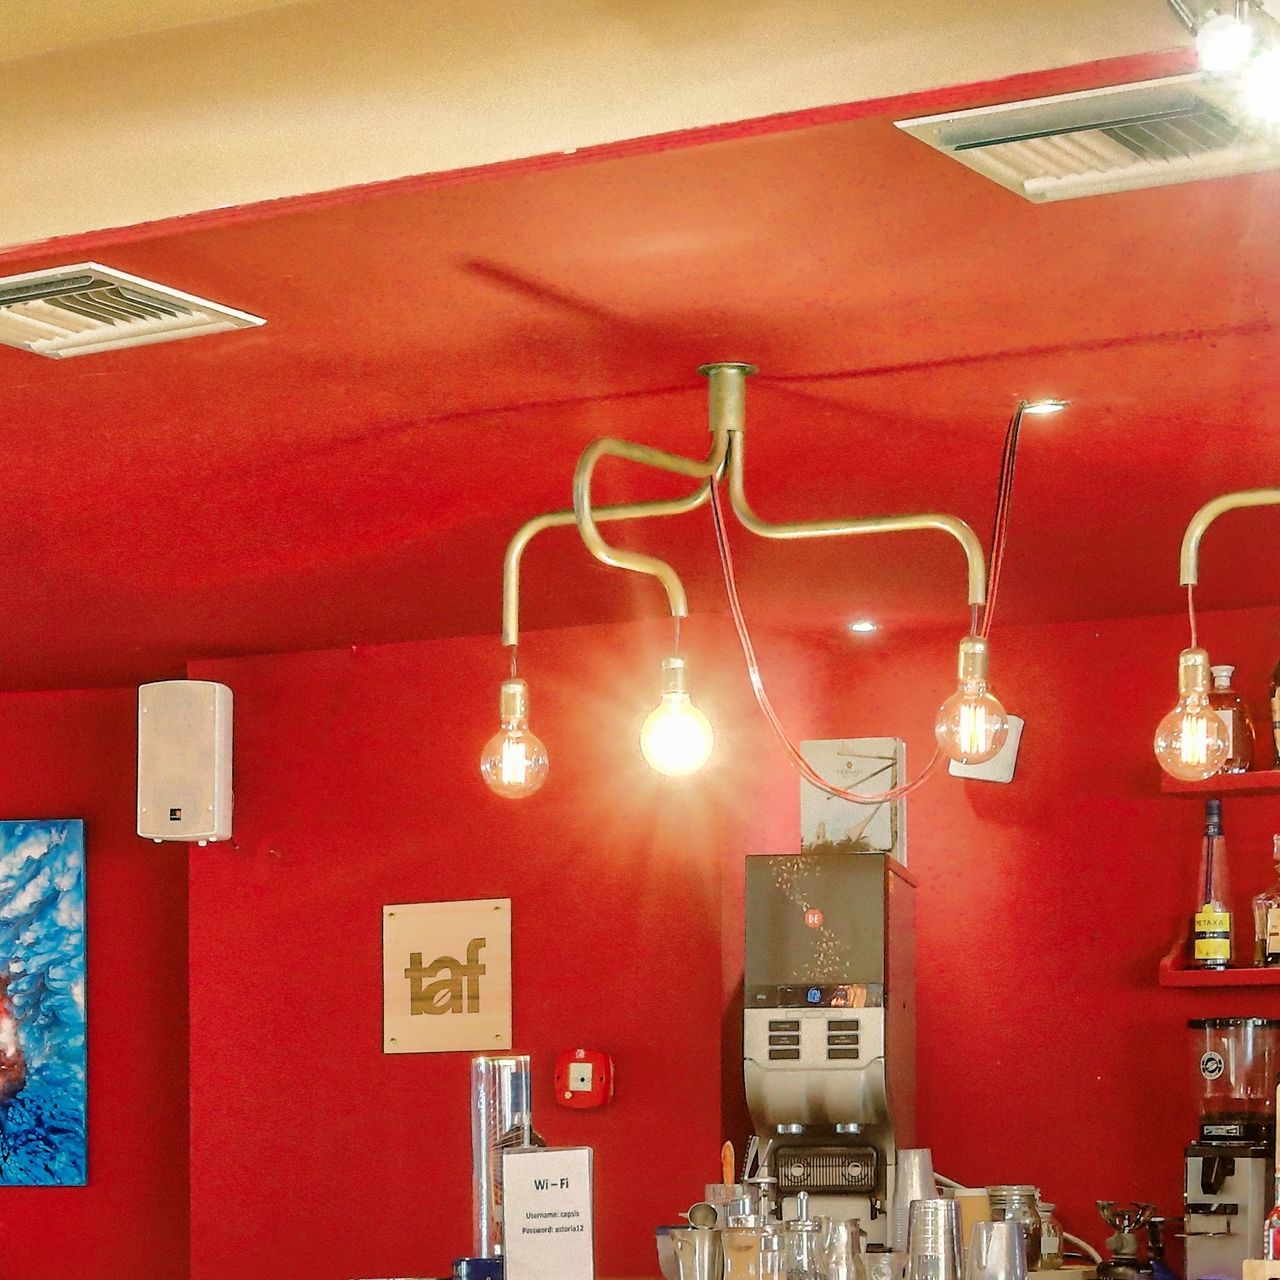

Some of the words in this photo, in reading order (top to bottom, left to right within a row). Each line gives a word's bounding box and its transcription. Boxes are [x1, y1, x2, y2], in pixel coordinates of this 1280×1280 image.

[807, 913, 819, 924] DE
[404, 937, 487, 1016] taf
[525, 1211, 559, 1219] Username:
[522, 1226, 554, 1235] Password:
